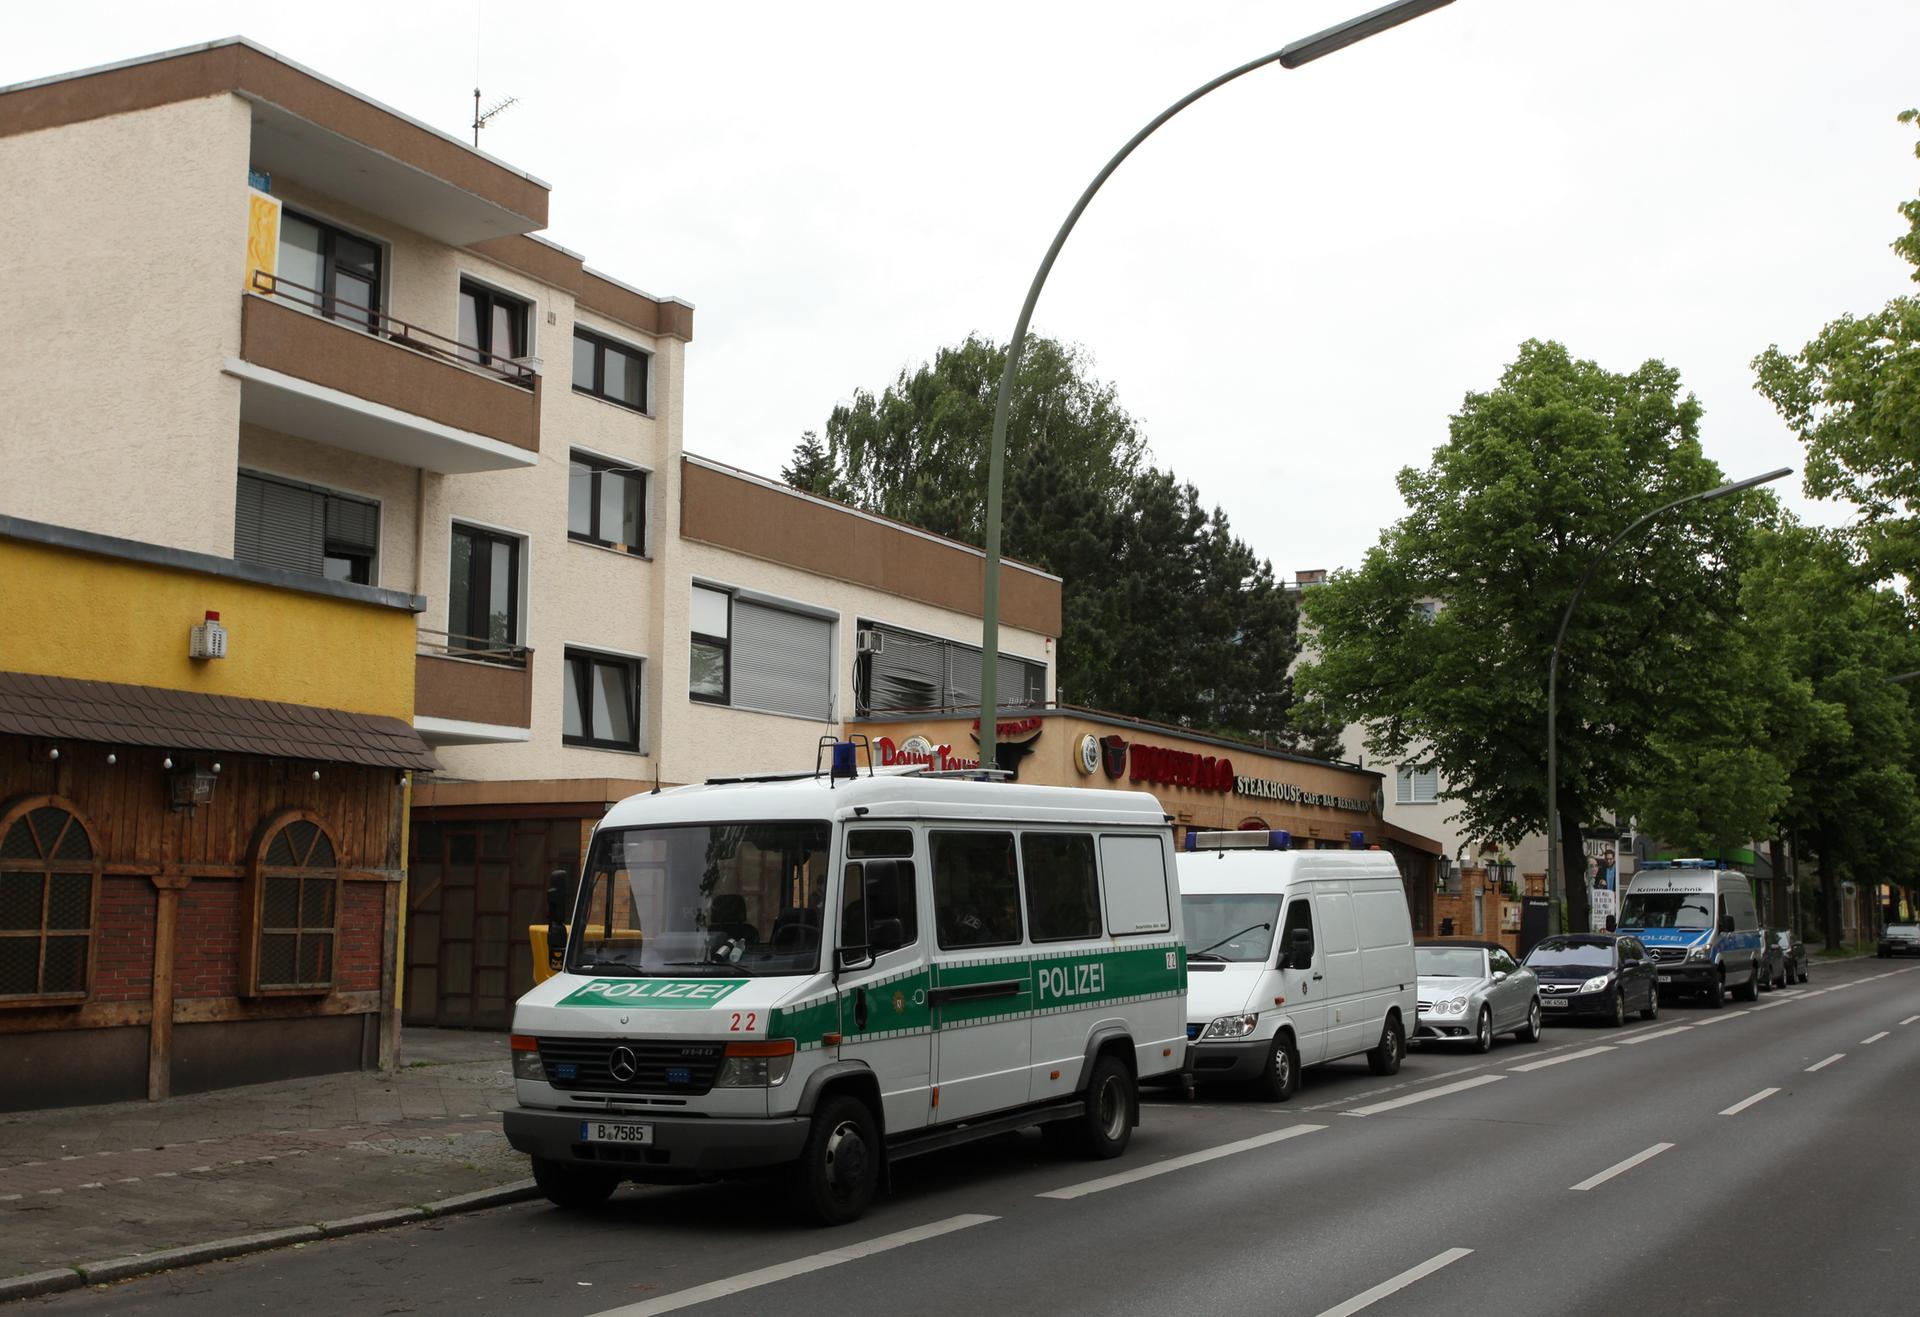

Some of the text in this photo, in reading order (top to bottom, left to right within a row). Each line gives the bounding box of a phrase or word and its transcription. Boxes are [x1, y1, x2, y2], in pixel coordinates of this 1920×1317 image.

[973, 716, 1042, 736] BFFALO
[1129, 743, 1234, 793] BUFFALO
[1237, 776, 1302, 802] STEAKHOUSE
[575, 983, 735, 999] POLIZEI
[1038, 963, 1105, 1000] POLIZEI
[730, 1012, 756, 1032] 22
[598, 1124, 644, 1141] B 7585
